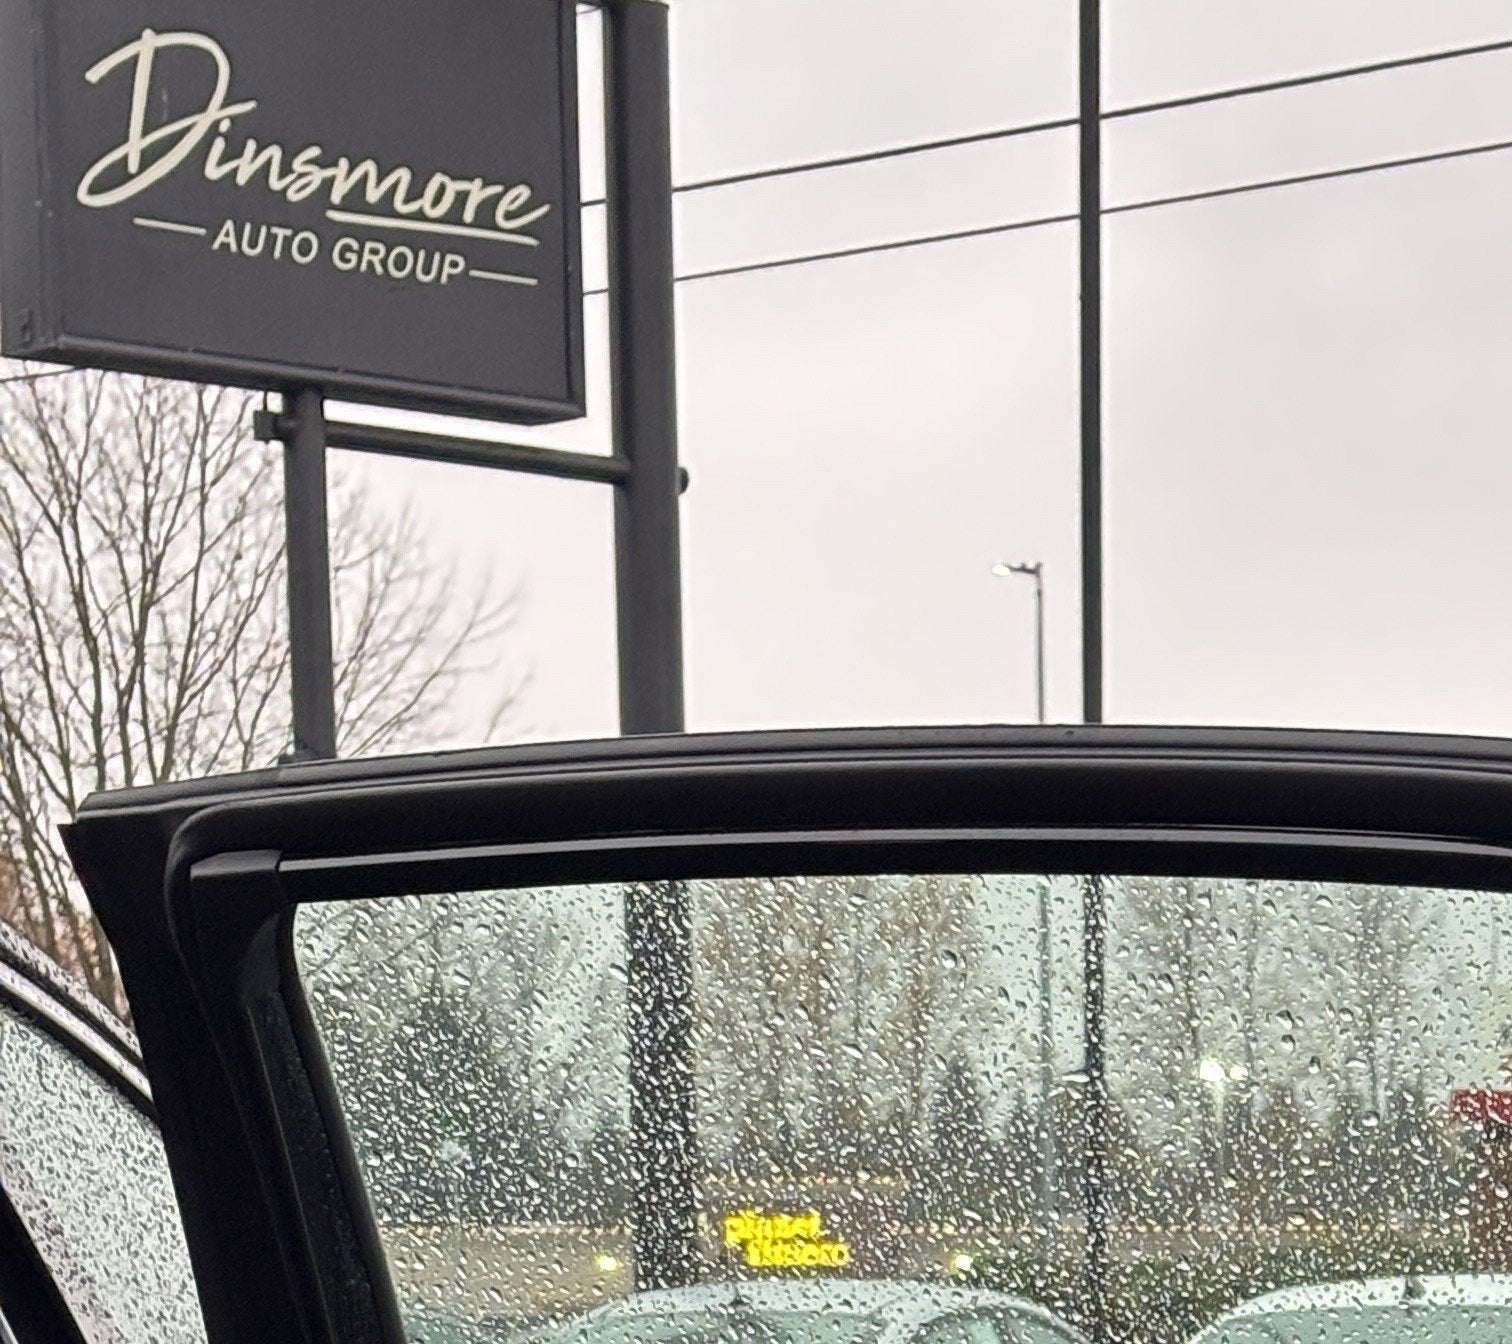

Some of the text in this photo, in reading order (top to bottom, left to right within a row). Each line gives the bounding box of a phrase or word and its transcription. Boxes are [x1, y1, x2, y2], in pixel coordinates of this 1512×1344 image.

[77, 28, 551, 231] Dinsmore
[211, 218, 466, 285] AUTO GROUP
